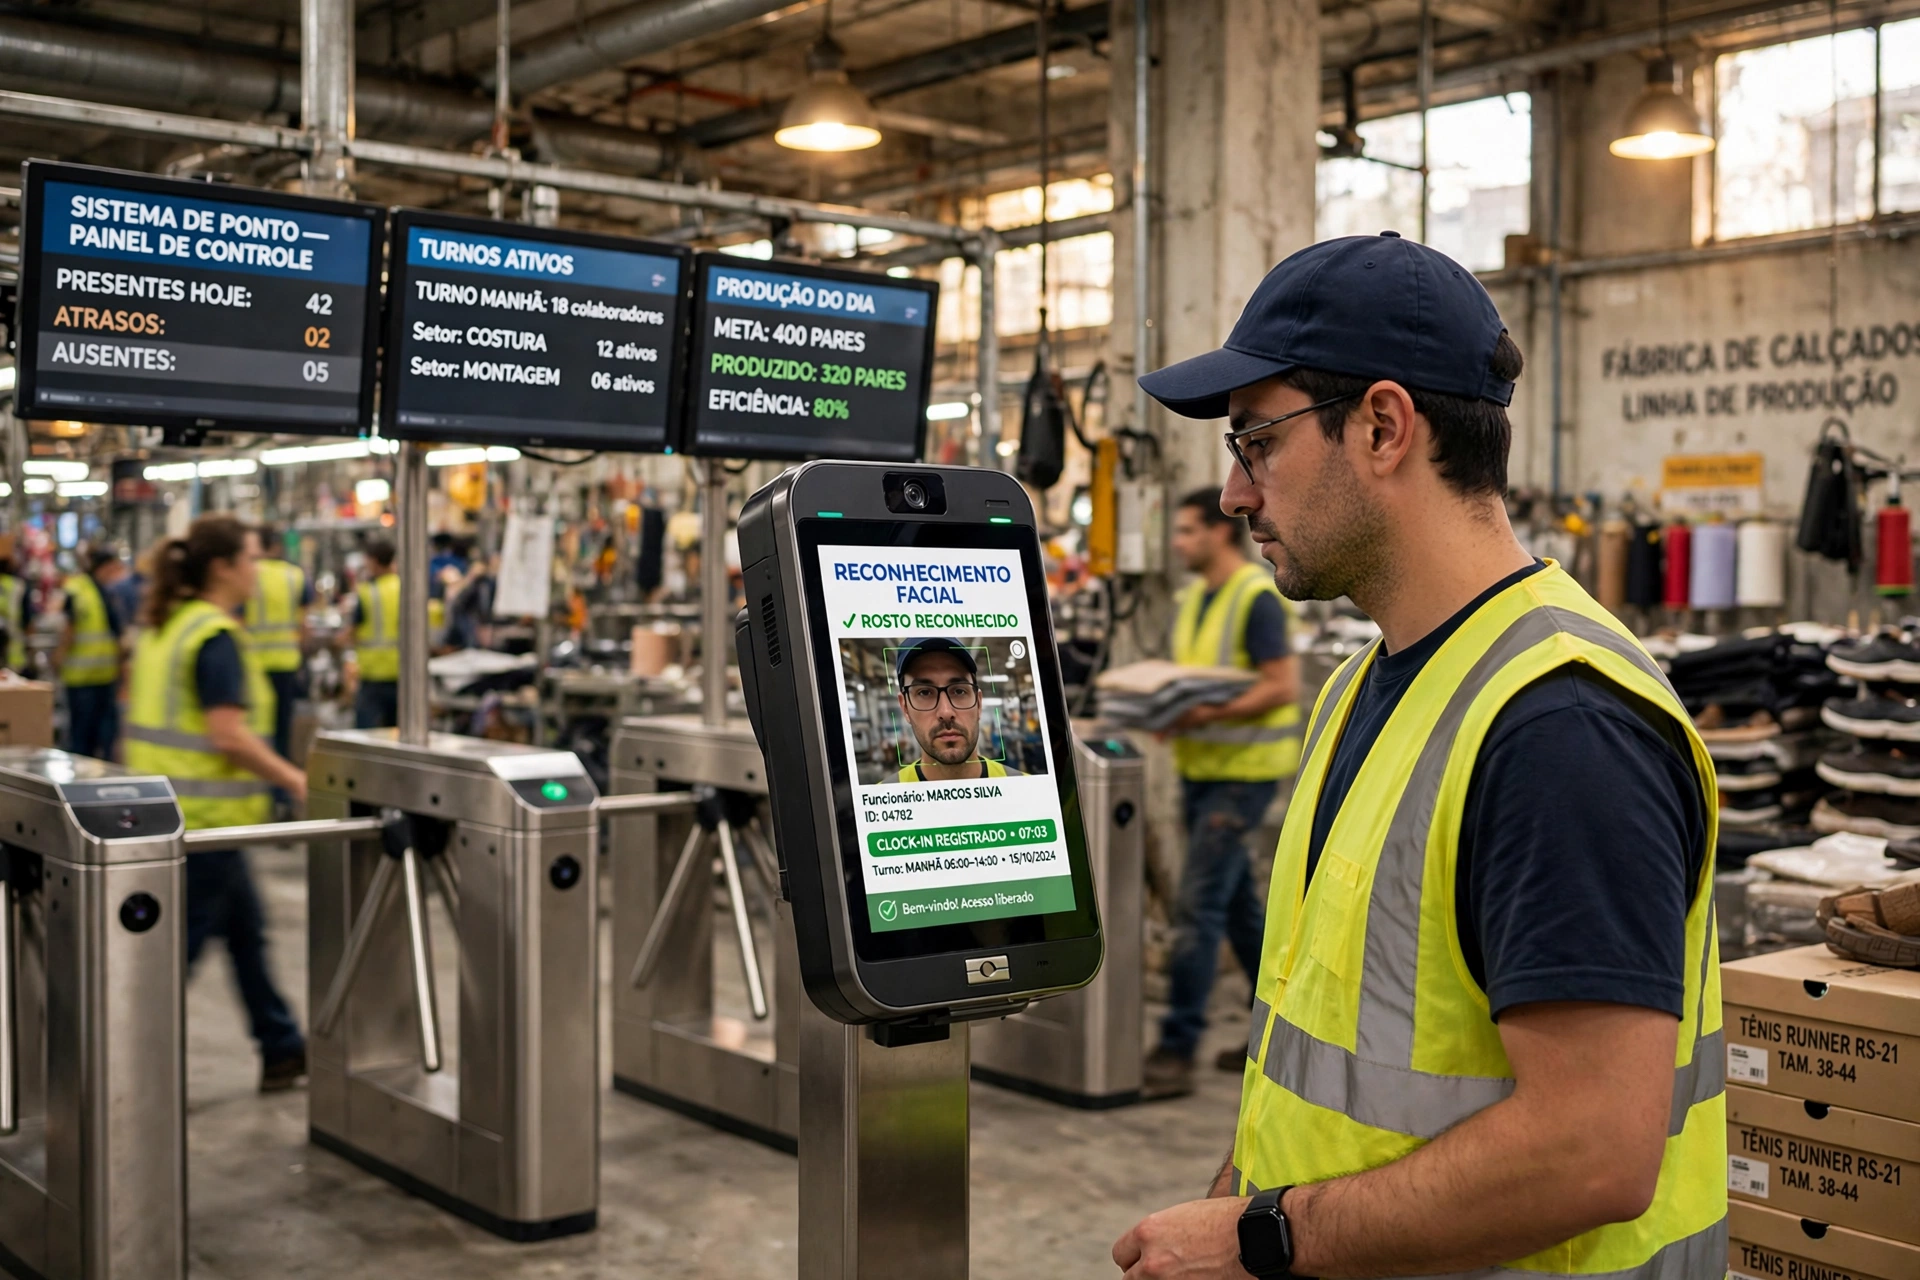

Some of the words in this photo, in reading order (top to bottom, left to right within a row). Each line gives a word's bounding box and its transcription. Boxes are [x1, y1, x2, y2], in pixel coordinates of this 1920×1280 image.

[71, 195, 177, 228] SISTEMA
[183, 208, 215, 232] DE
[220, 213, 300, 243] PONTO
[69, 223, 153, 254] PAINEL
[159, 234, 190, 258] DE
[195, 237, 313, 271] CONTROLE
[419, 237, 501, 267] TURNOS
[504, 249, 574, 275] ATIVOS
[57, 268, 184, 302] PRESENTES
[190, 281, 252, 308] HOJE:
[305, 293, 333, 315] 42
[415, 280, 477, 305] TURNO
[481, 287, 548, 313] MANHÃ:
[551, 297, 569, 314] 18
[570, 301, 664, 325] colaboradores
[716, 276, 815, 308] PRODUÇÃO
[817, 289, 843, 310] DO
[846, 293, 876, 314] DIA
[53, 305, 165, 335] ATRASOS:
[304, 327, 330, 349] 02
[413, 321, 462, 344] Setor:
[466, 326, 547, 352] COSTURA
[597, 340, 613, 358] 12
[615, 342, 657, 362] ativos
[714, 316, 769, 342] META:
[772, 323, 807, 346] 400
[810, 327, 866, 352] PARES
[52, 341, 176, 372] AUSENTES:
[303, 360, 329, 383] 05
[410, 356, 460, 378] Setor:
[463, 360, 560, 386] MONTAGEM
[591, 371, 611, 390] 06
[613, 374, 655, 394] ativos
[711, 353, 817, 382] PRODUZIDO:
[820, 363, 852, 385] 320
[855, 367, 907, 391] PARES
[1602, 340, 1717, 379] FÁBRICA
[1724, 336, 1760, 372] DE
[709, 387, 810, 416] EFICIÊNCIA:
[813, 398, 849, 419] 80%
[1622, 389, 1697, 423] LINHA
[1705, 384, 1737, 416] DE
[1747, 368, 1898, 413] PRODUÇÃO
[834, 562, 1011, 583] RECONHECIMENTO
[896, 585, 963, 604] FACIAL
[861, 613, 911, 629] ROSTO
[915, 613, 1018, 628] RECONHECIDO
[862, 790, 925, 806] Funcionário:
[926, 787, 972, 802] MARCOS
[974, 786, 1002, 798] SILVA
[865, 810, 880, 822] ID:
[881, 809, 913, 822] 04782
[876, 834, 933, 851] CLOCK-IN
[935, 829, 1006, 847] REGISTRADO
[1018, 826, 1048, 839] 07:03
[872, 865, 904, 876] Turno:
[905, 857, 943, 873] MANHÃ
[1009, 850, 1056, 865] 15/10/2024
[902, 898, 959, 915] Bem-vindo!
[961, 897, 994, 909] Acesso
[995, 891, 1034, 905] liberado
[1740, 1014, 1781, 1042] TÊNIS
[1787, 1025, 1850, 1056] RUNNER
[1855, 1037, 1898, 1064] RS-21
[1778, 1051, 1812, 1074] TAM.
[1817, 1058, 1856, 1083] 38-44
[1741, 1128, 1783, 1158] TÊNIS
[1788, 1142, 1852, 1174] RUNNER
[1858, 1156, 1901, 1186] RS-21
[1779, 1166, 1814, 1192] TAM.
[1818, 1175, 1859, 1202] 38-44
[1741, 1245, 1783, 1276] TÊNIS
